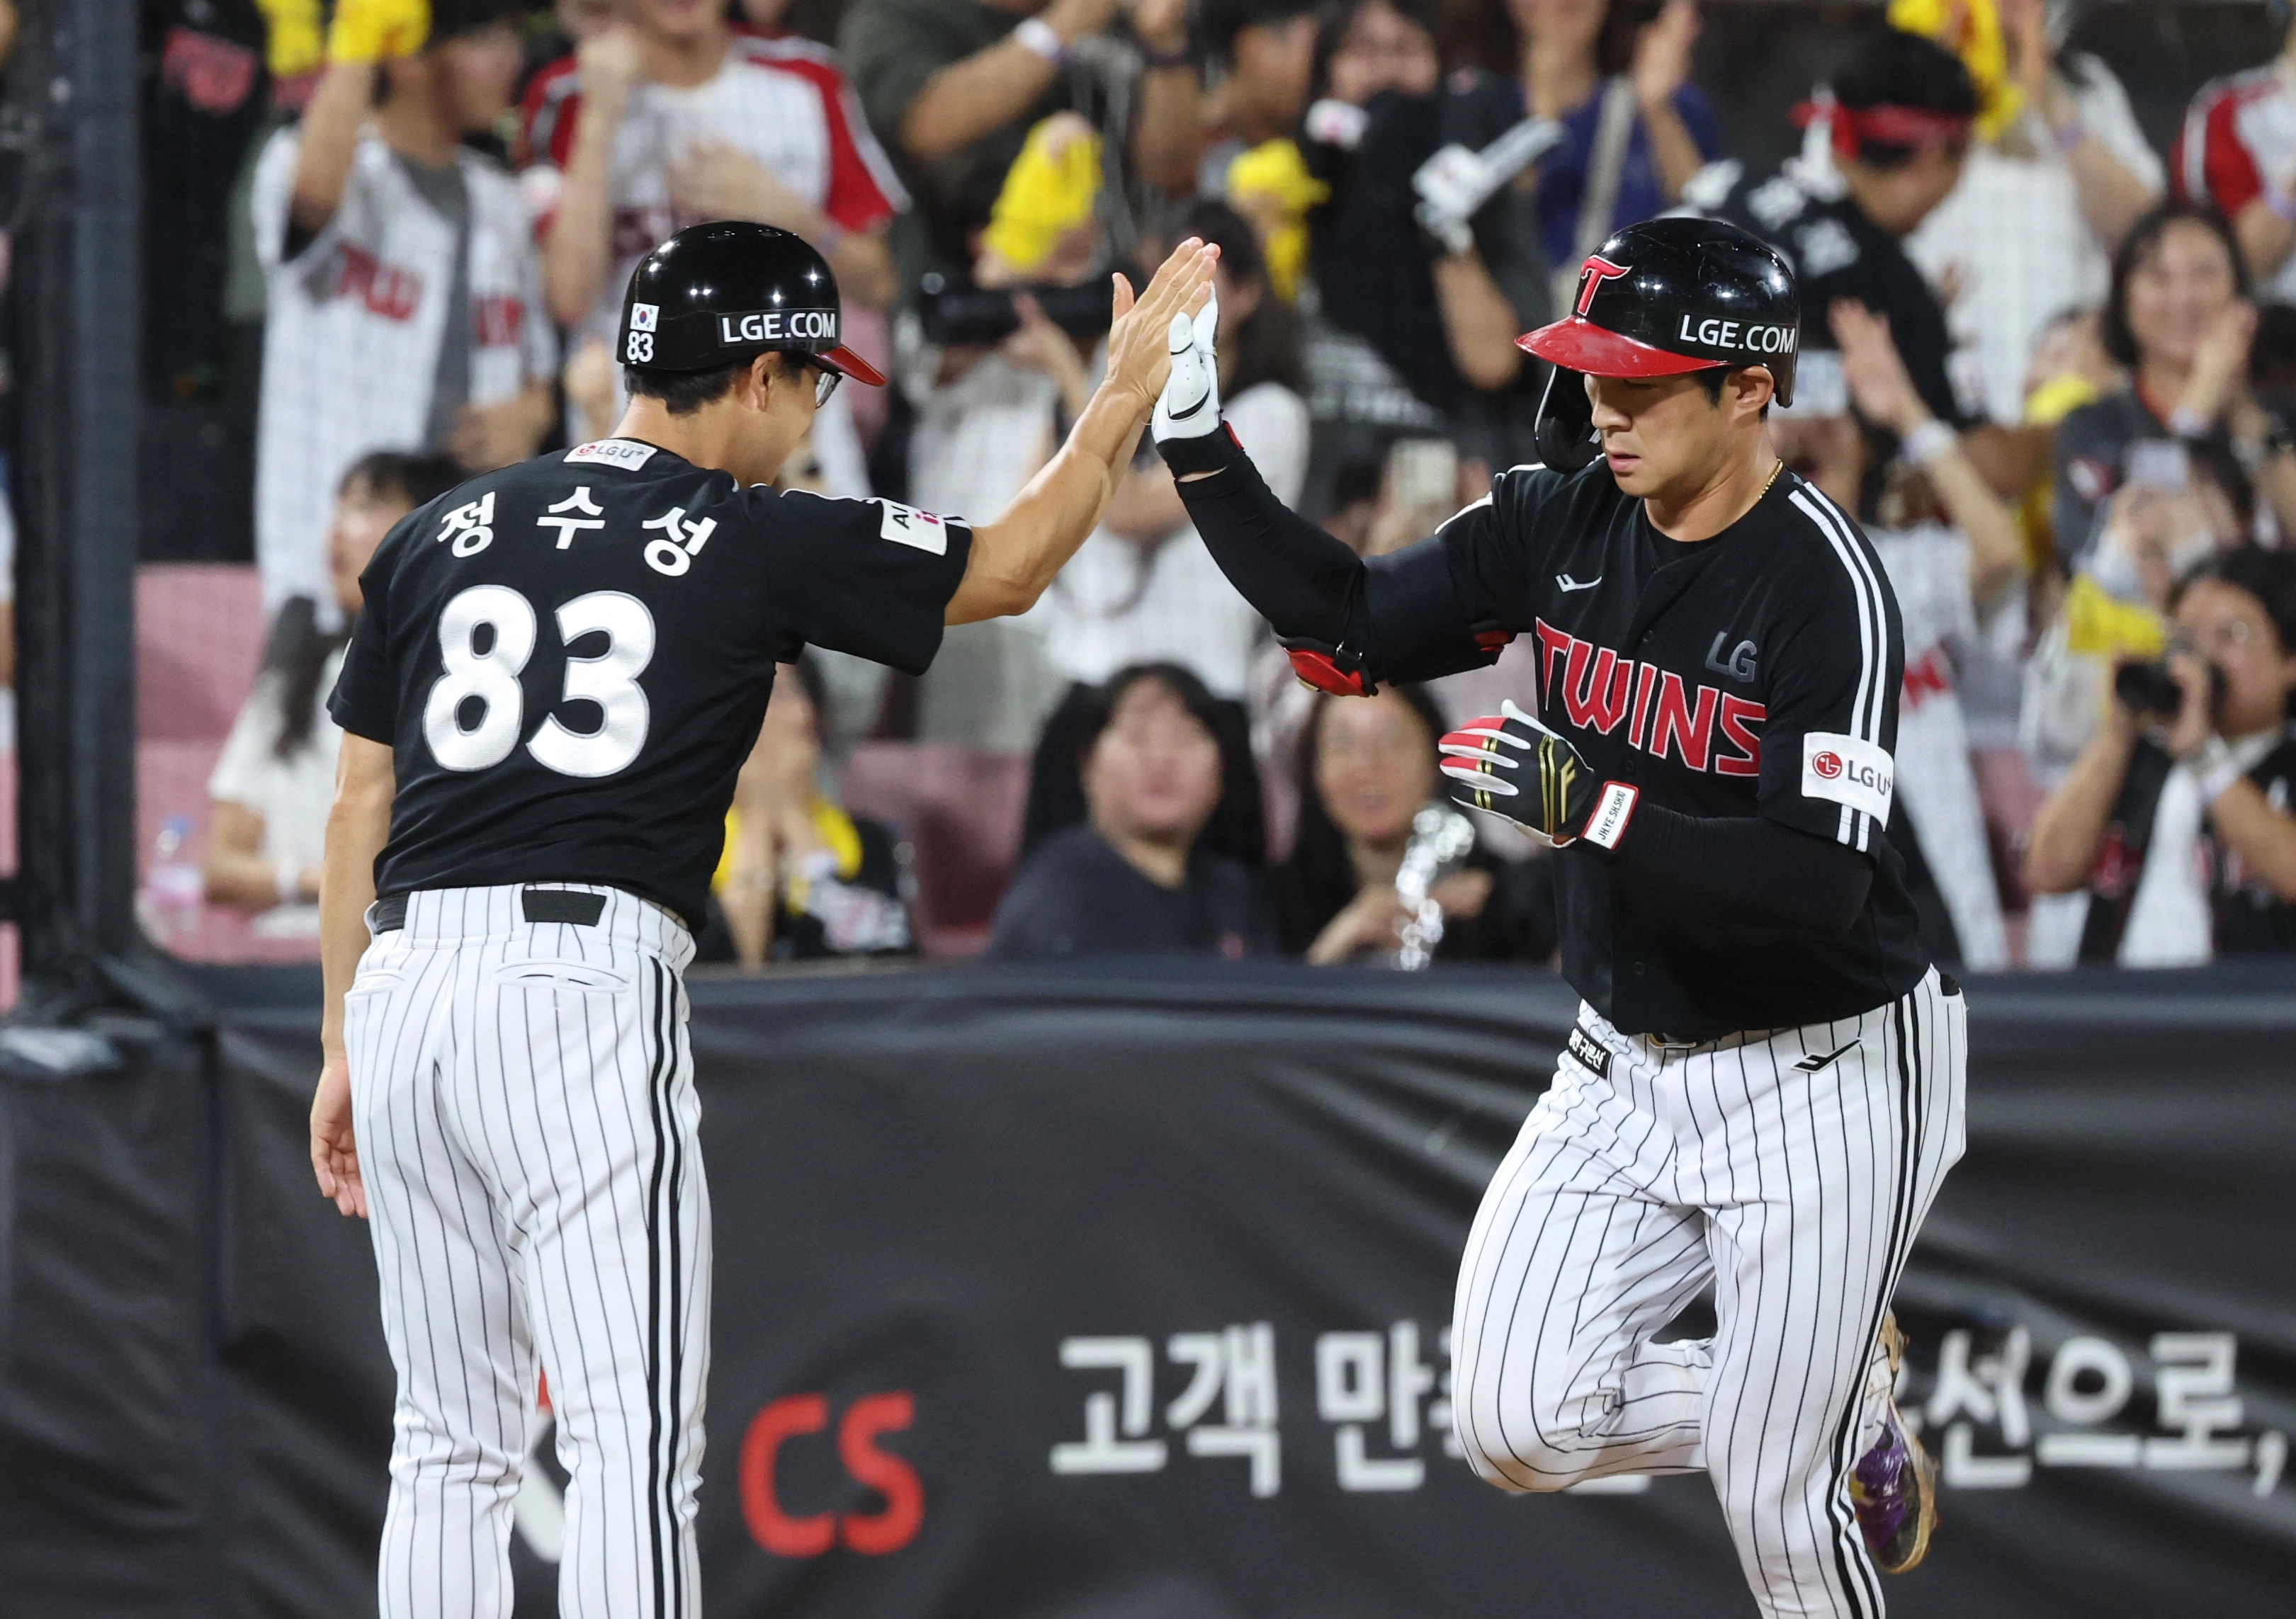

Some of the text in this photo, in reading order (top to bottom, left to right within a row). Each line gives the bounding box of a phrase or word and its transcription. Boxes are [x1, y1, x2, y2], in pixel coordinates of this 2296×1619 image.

[626, 331, 655, 363] 83
[721, 312, 836, 343] LGE.COM
[1679, 314, 1796, 354] LGE.COM
[890, 504, 910, 530] AI
[424, 584, 657, 778] 83
[1704, 630, 1758, 683] LG
[1535, 615, 1768, 778] TWINS
[1049, 1318, 1282, 1499] 고객
[1893, 1323, 2289, 1497] 선으로,
[737, 1389, 926, 1559] CS
